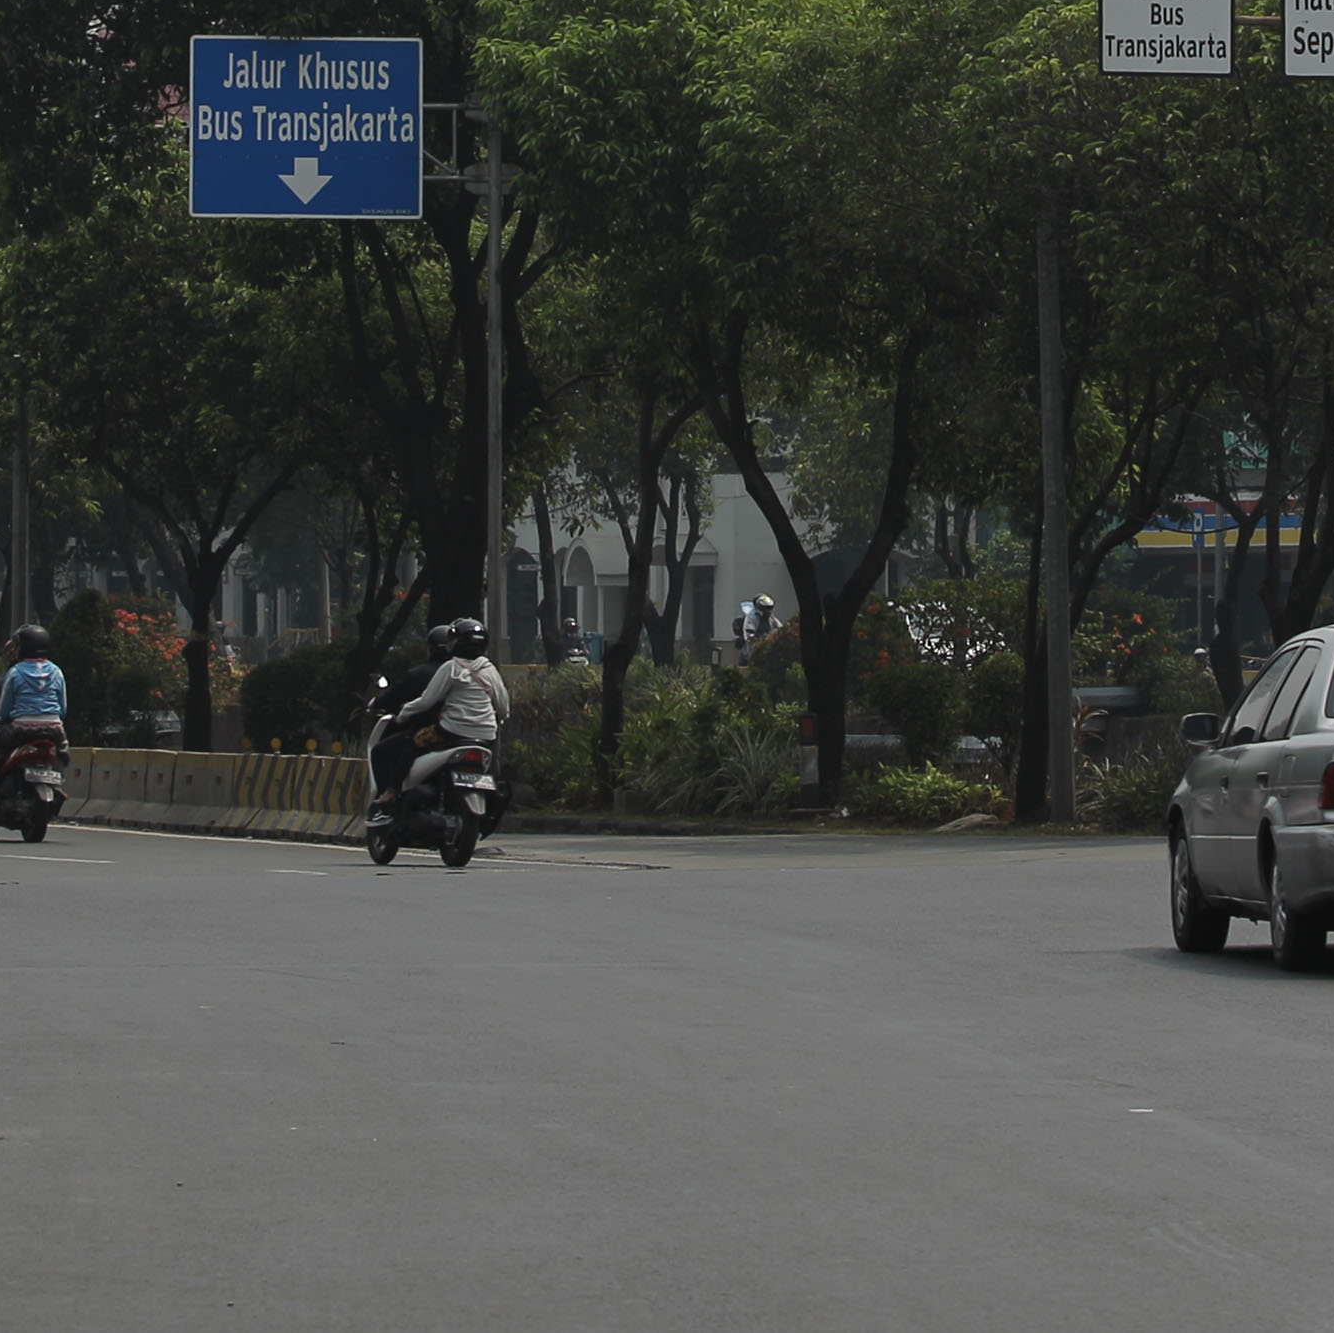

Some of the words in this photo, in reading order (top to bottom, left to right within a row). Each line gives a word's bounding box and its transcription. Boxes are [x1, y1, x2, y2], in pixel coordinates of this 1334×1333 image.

[1150, 3, 1184, 25] Bus
[1105, 33, 1227, 64] Transjakarta
[223, 51, 286, 89] Jalur
[298, 51, 390, 90] Khusus
[198, 105, 243, 141] Bus
[252, 102, 414, 152] Transjakarta
